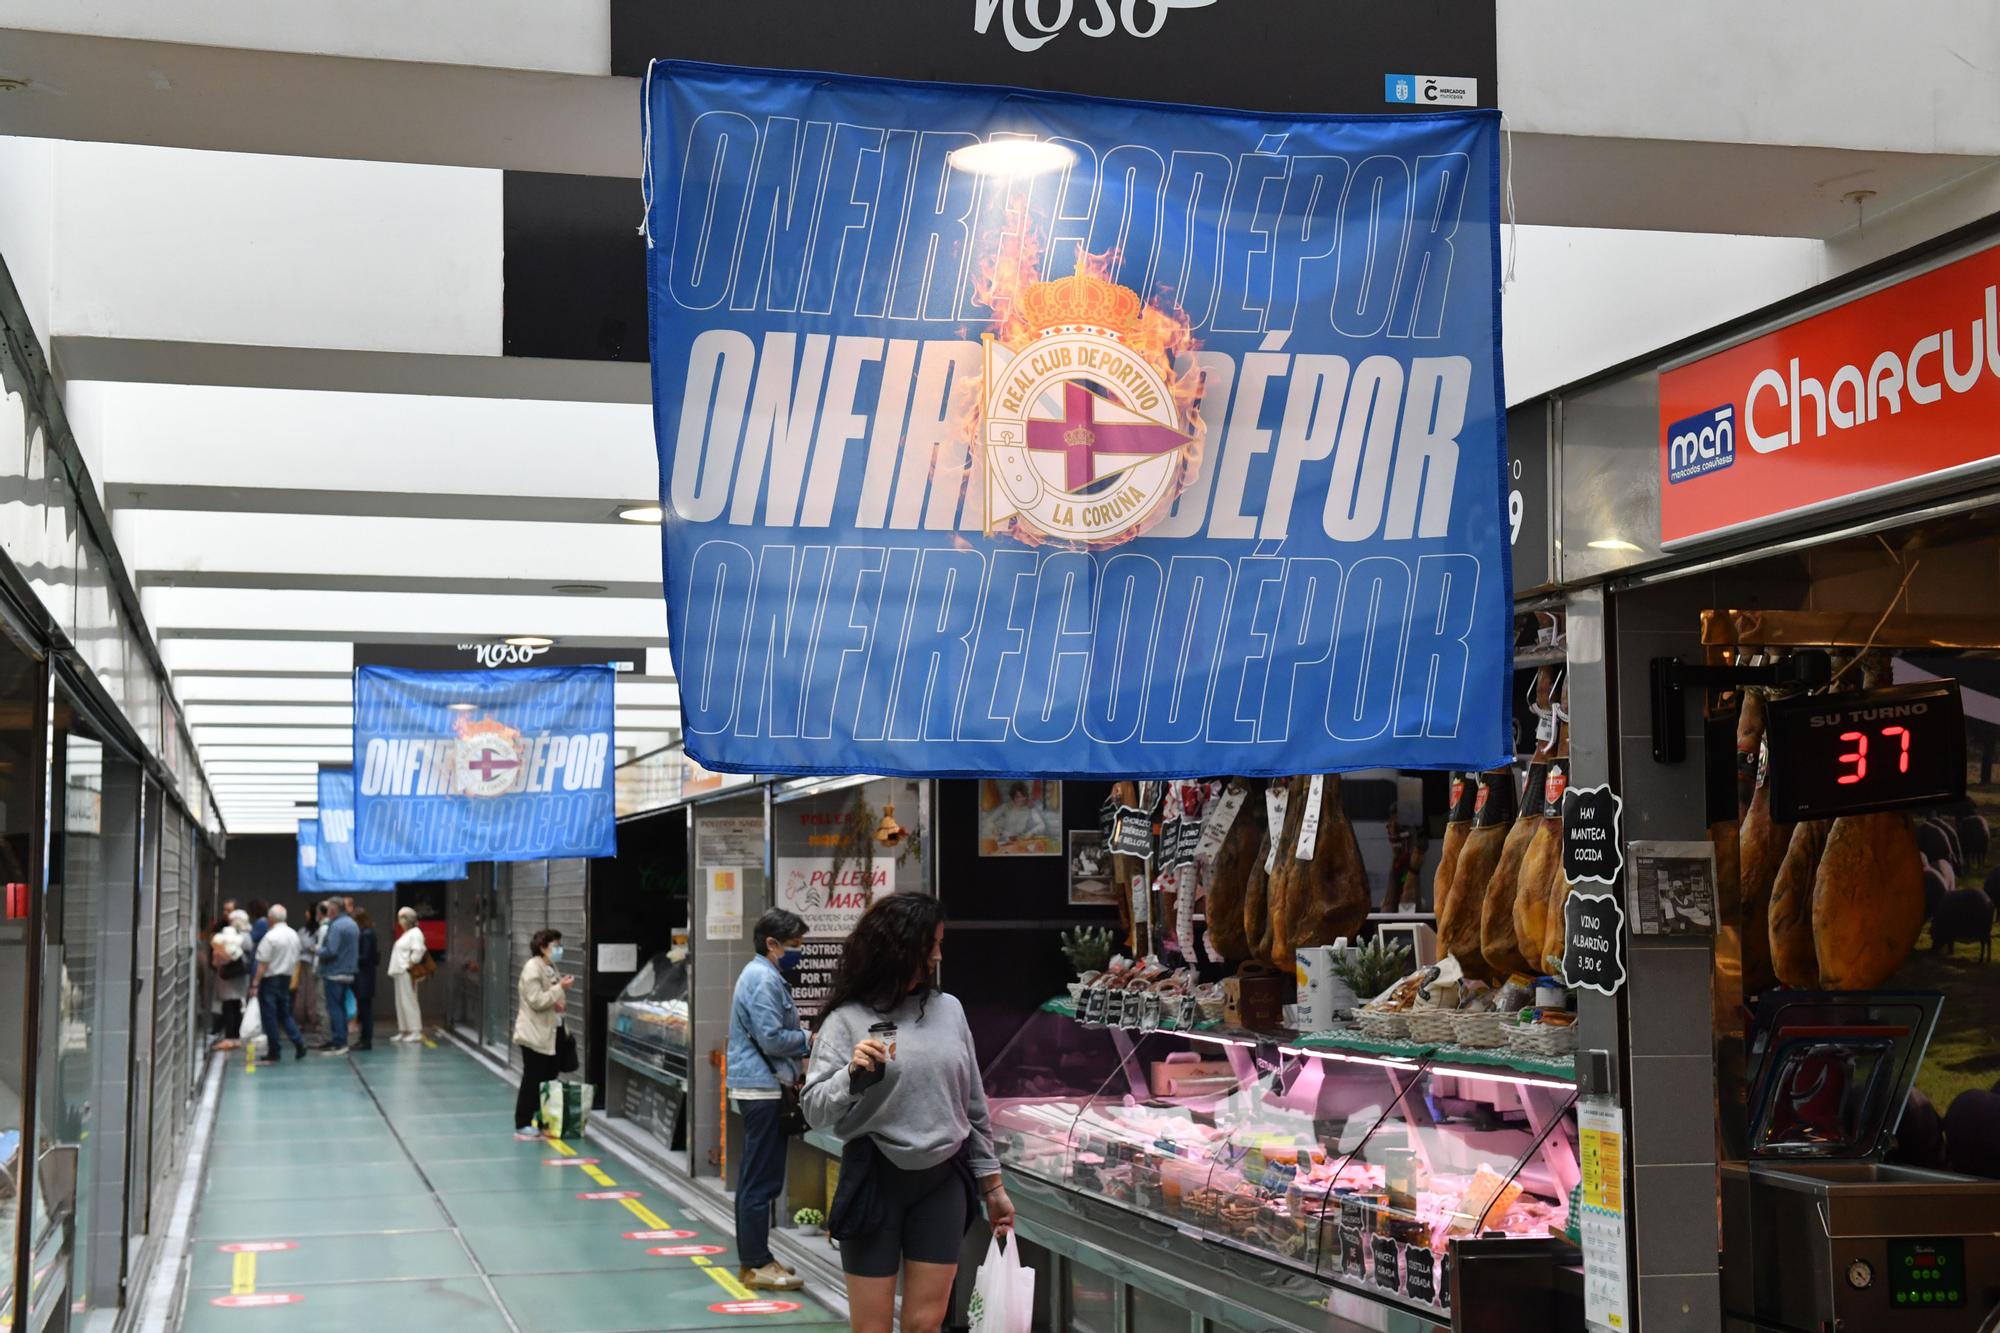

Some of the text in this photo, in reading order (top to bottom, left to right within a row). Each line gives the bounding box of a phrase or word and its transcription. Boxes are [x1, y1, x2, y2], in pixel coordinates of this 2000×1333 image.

[1002, 346, 1159, 414] REAL CLUB DEPORTIVO
[1052, 485, 1147, 528] LA CORUÑA
[687, 539, 1480, 744] ONFIRECODÉPOR
[1809, 702, 1929, 728] SU TURNO
[1837, 726, 1911, 785] 37
[1580, 807, 1595, 820] HAY
[1571, 827, 1606, 841] MANTECA
[1574, 848, 1603, 861] COCIDA
[1581, 915, 1600, 930] VINO
[800, 944, 843, 955] OSOTROS
[1573, 934, 1609, 953] ALBARIÑO
[1578, 955, 1602, 971] 3,50 €
[801, 973, 820, 983] POR
